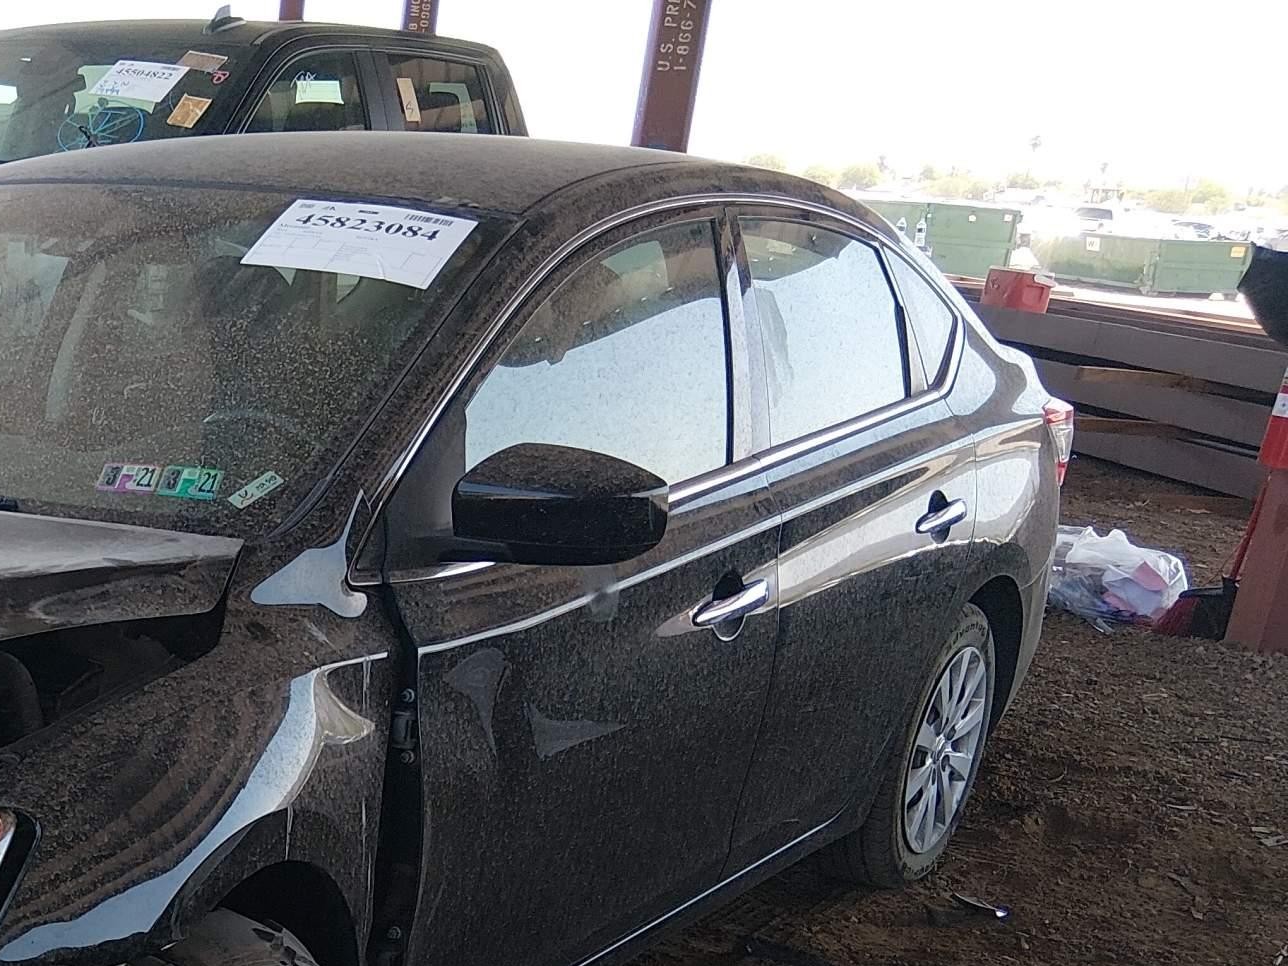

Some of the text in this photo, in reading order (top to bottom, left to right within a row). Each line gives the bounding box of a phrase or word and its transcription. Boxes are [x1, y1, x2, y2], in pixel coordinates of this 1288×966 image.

[657, 38, 675, 71] U.S.
[296, 213, 441, 241] 45823084
[136, 467, 157, 487] 21
[198, 471, 218, 494] 21
